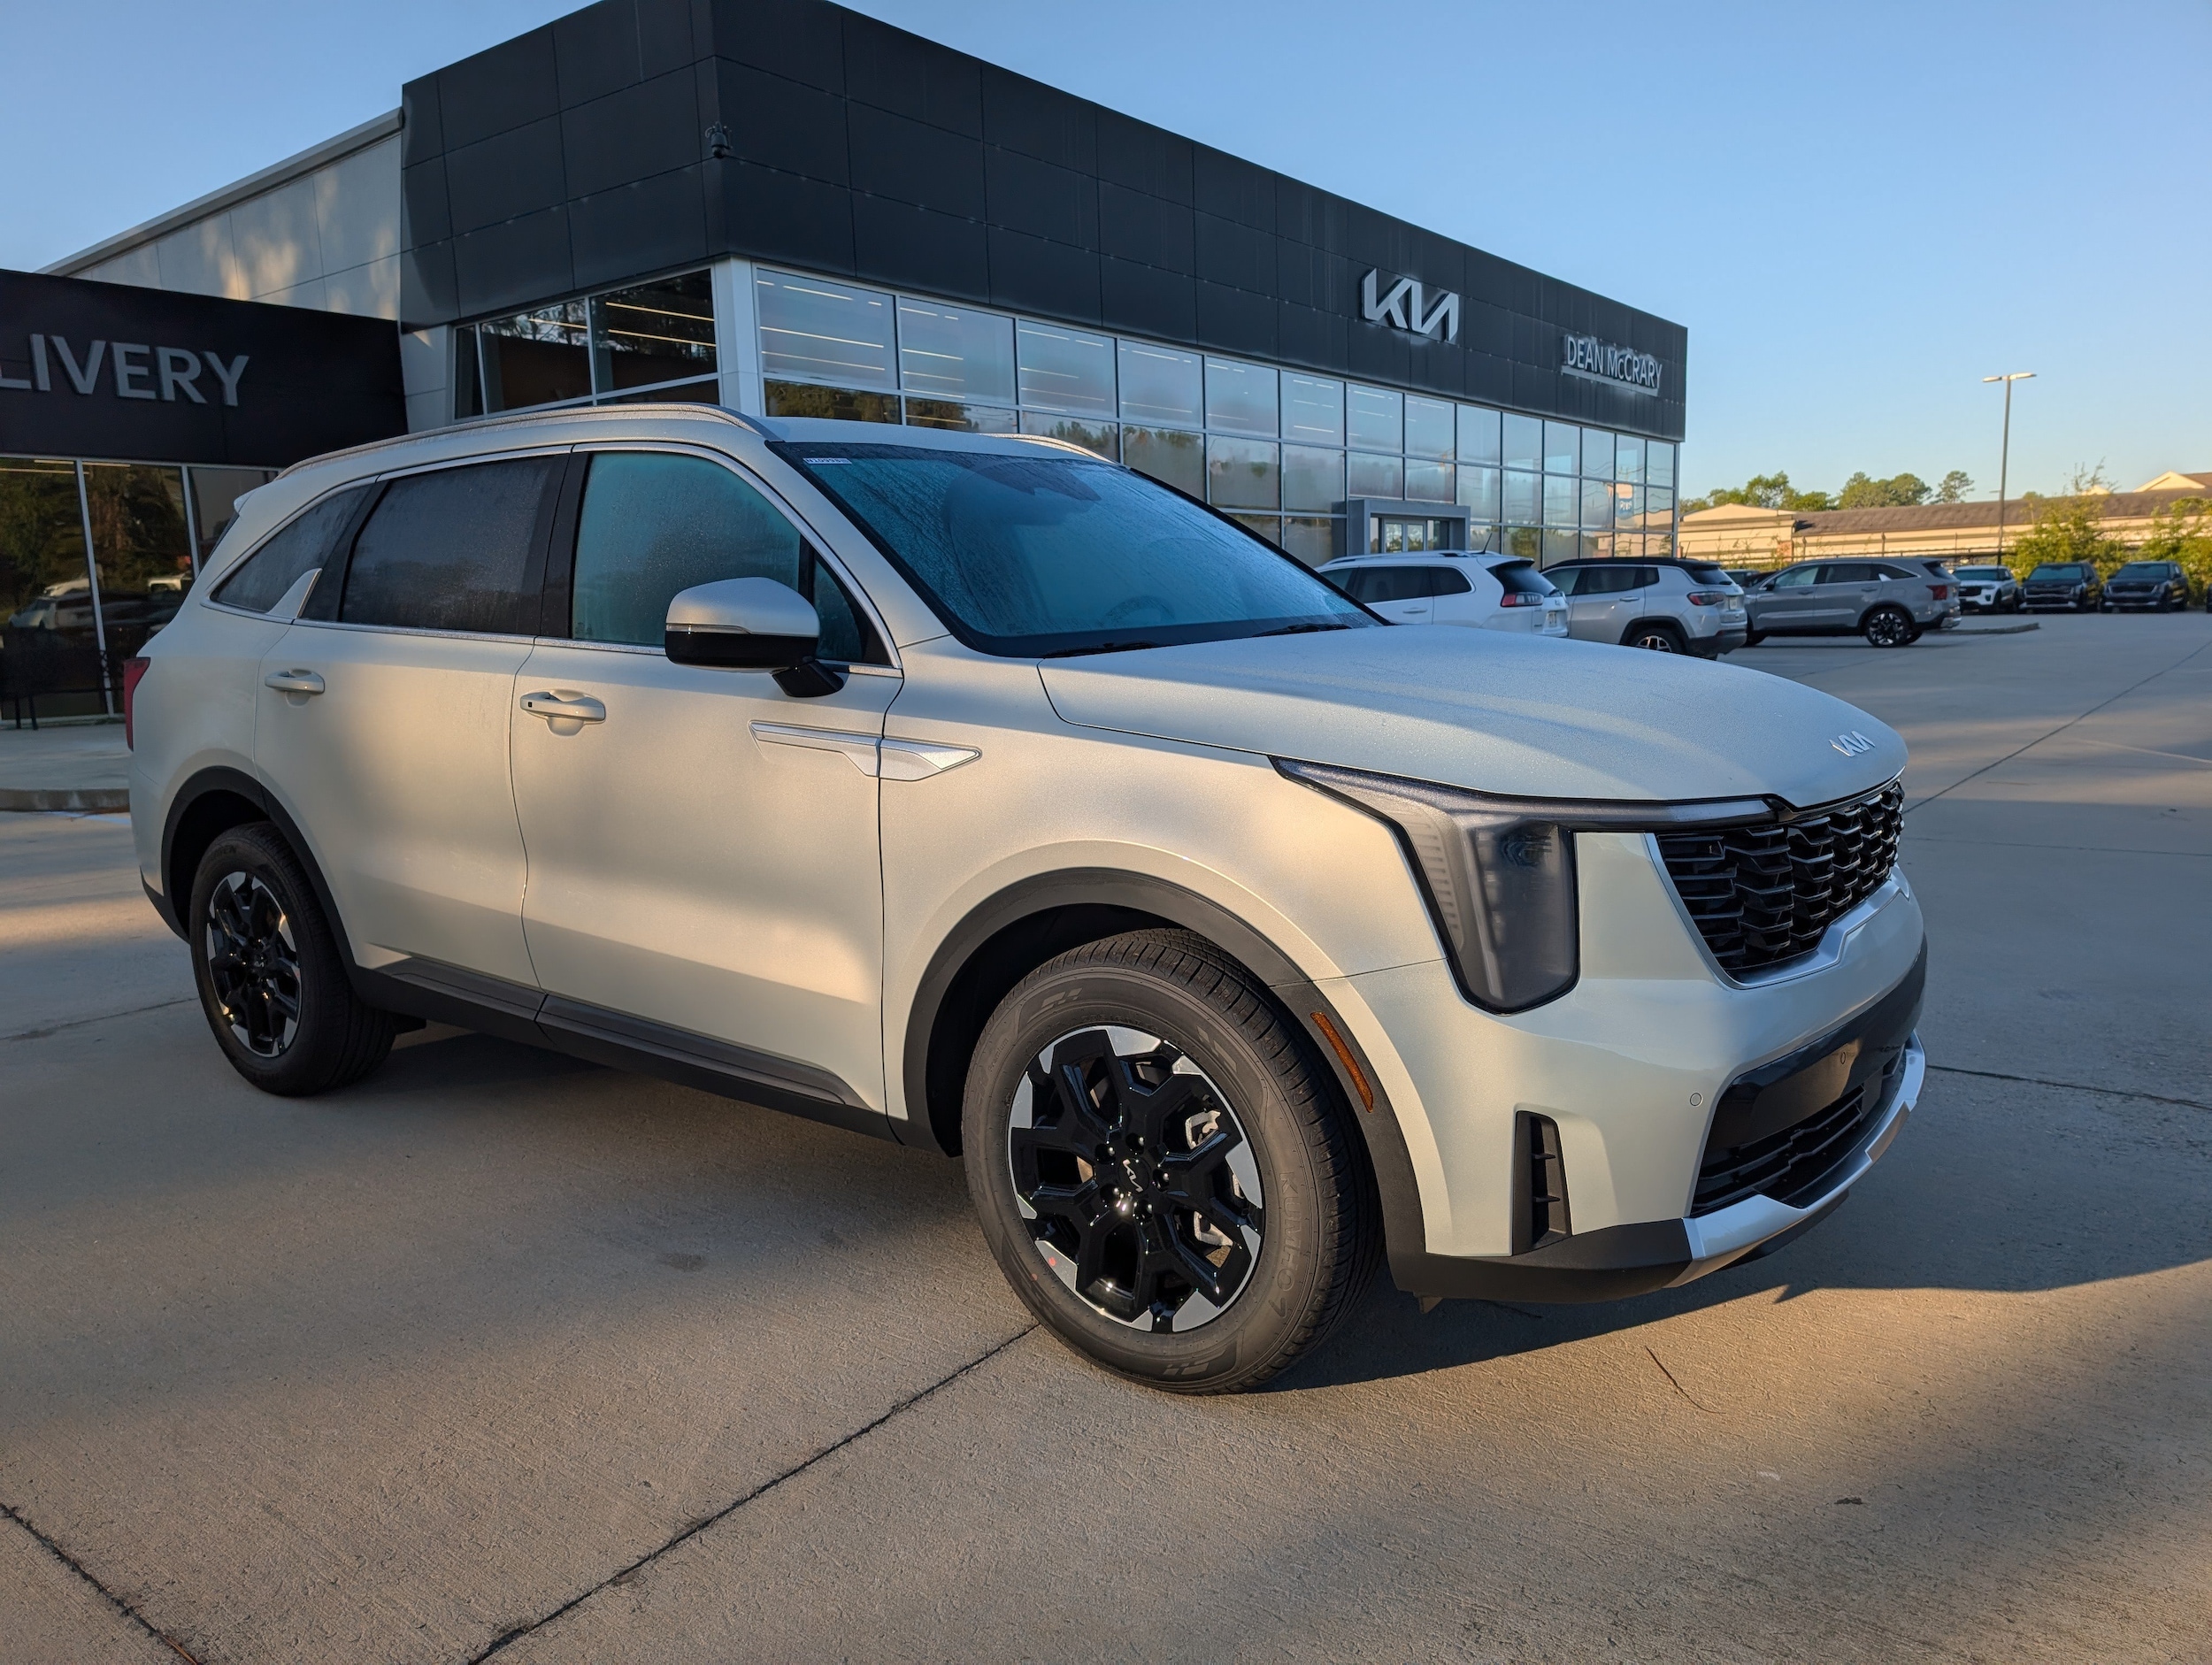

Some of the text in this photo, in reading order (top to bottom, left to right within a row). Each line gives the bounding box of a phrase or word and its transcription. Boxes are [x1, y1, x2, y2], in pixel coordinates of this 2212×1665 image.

[1363, 267, 1459, 341] KIA
[1565, 335, 1663, 389] DEAN McCRARY
[1278, 1170, 1302, 1292] KUMHO
